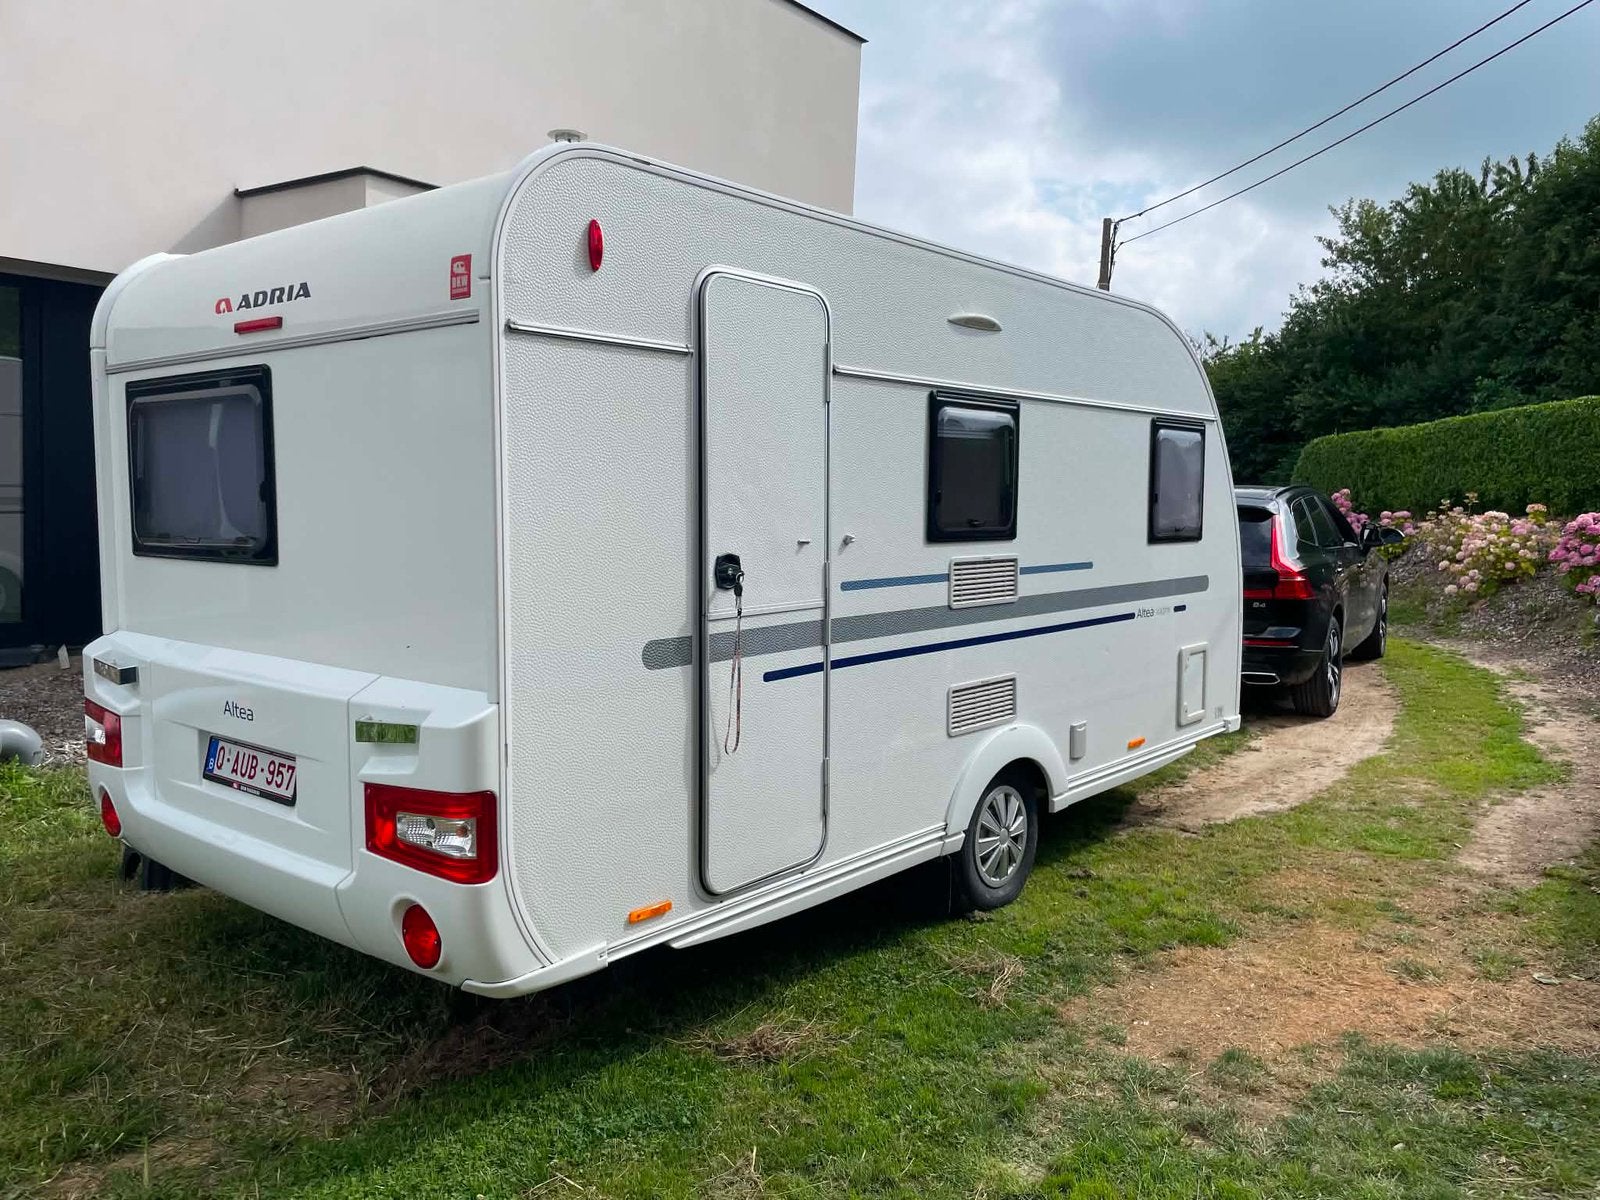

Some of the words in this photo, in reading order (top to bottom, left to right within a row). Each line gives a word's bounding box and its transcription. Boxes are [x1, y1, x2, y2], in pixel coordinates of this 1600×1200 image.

[236, 282, 311, 311] ADRIA
[1136, 605, 1155, 618] Altea
[223, 700, 254, 721] Altea
